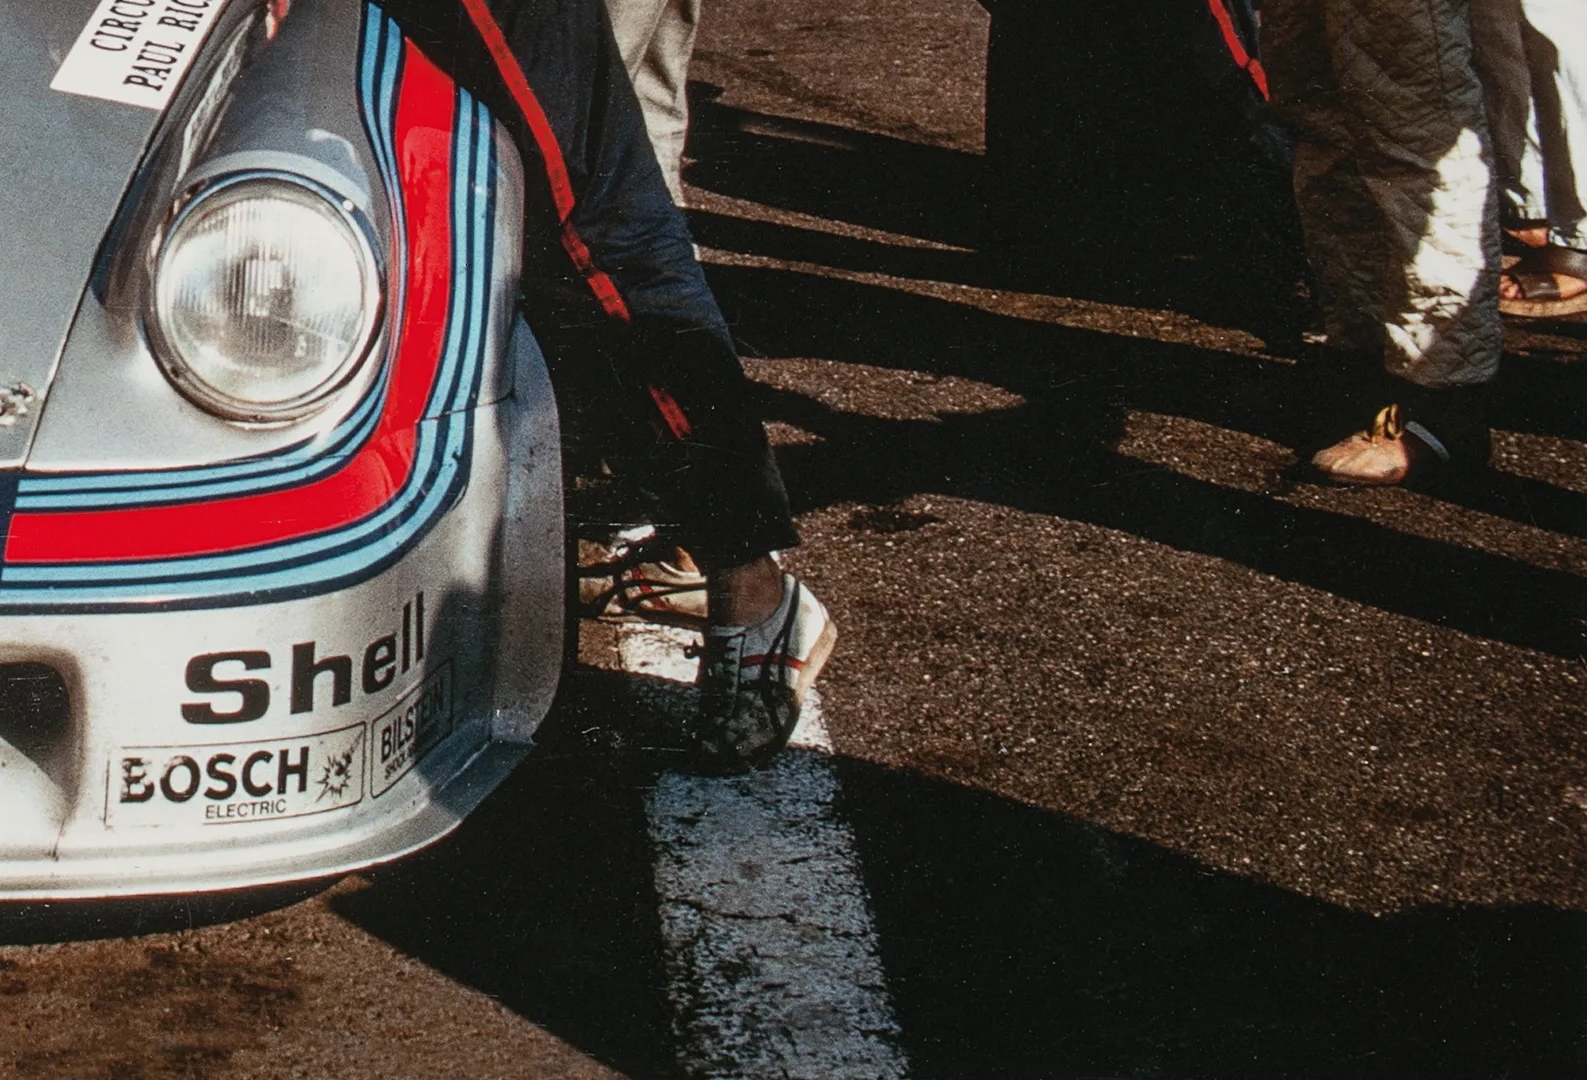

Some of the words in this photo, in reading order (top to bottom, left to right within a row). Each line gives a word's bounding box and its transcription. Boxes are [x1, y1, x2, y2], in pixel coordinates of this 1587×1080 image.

[123, 40, 186, 92] PAUL
[180, 591, 424, 724] Shell
[120, 746, 309, 803] BOSCH
[205, 798, 288, 819] ELECTRIC
